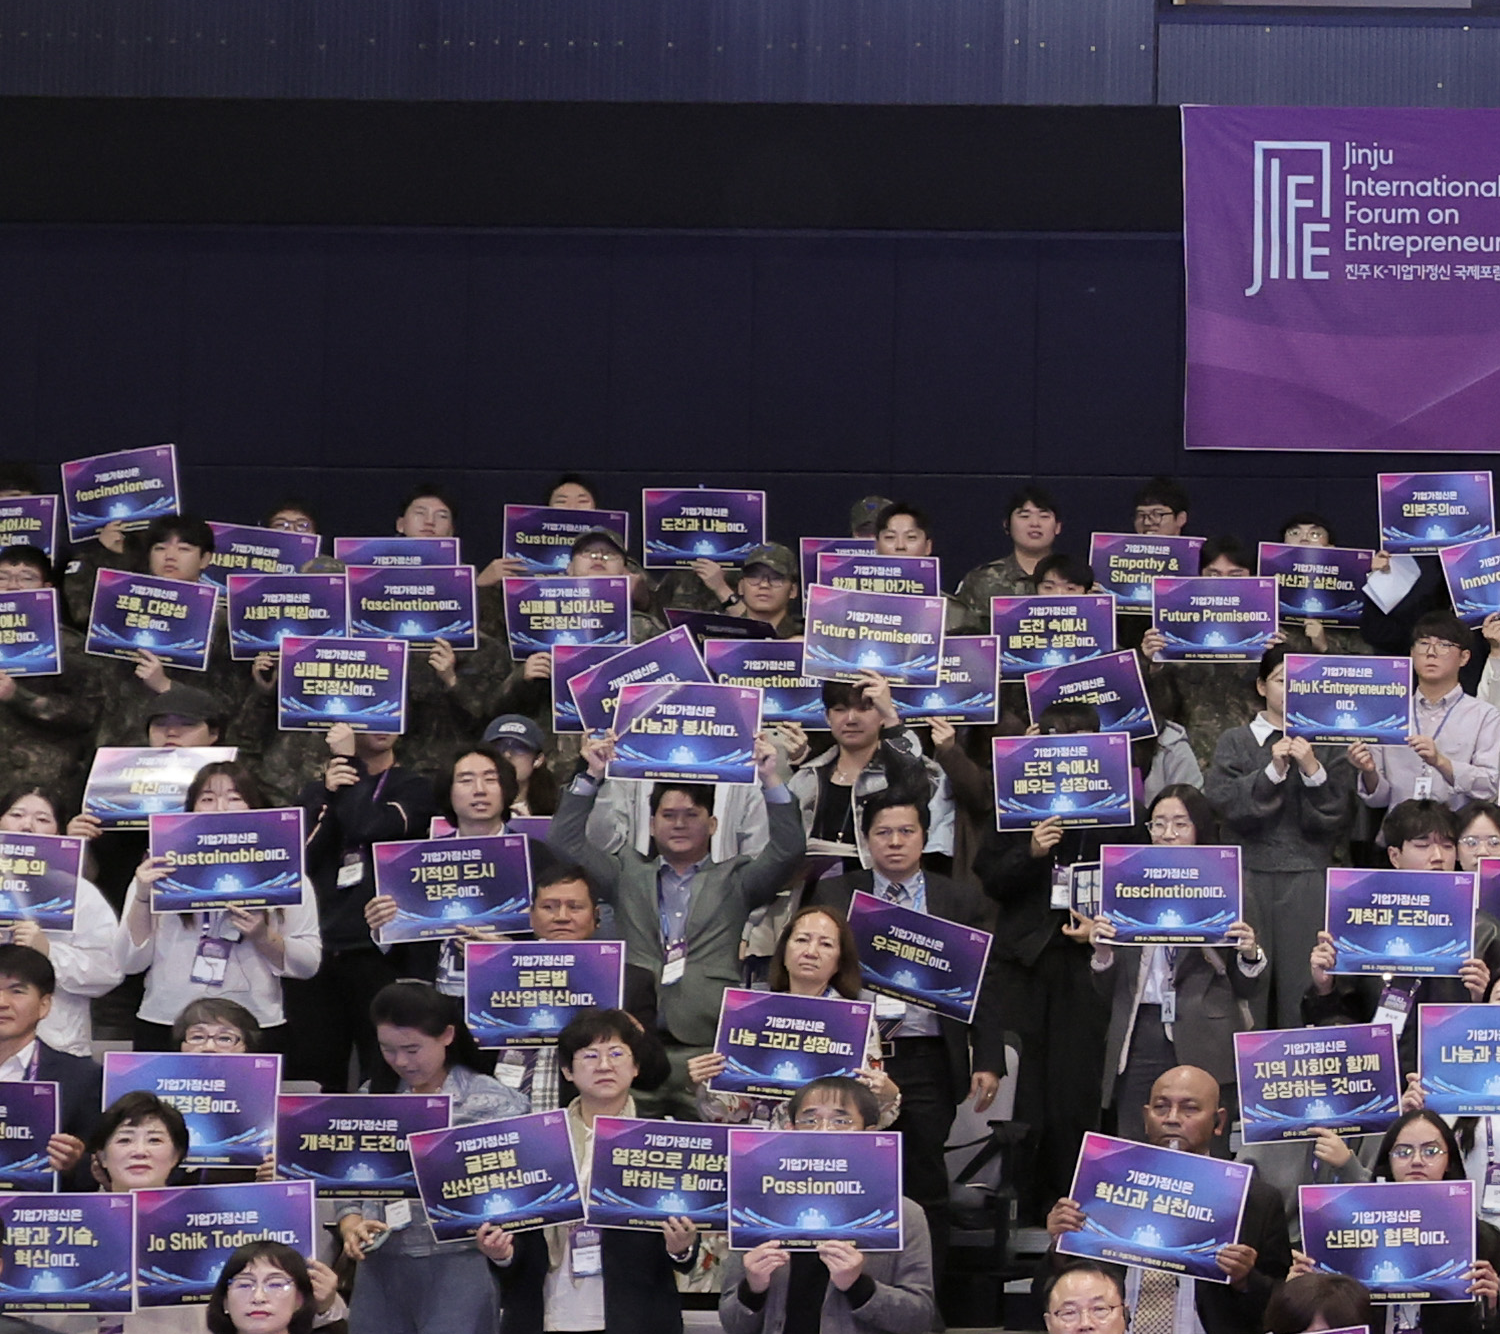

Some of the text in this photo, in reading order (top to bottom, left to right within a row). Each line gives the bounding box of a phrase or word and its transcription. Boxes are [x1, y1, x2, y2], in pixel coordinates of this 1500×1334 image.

[1342, 141, 1393, 171] Jinju
[1345, 200, 1459, 225] Forum on
[1344, 263, 1372, 280] 진주
[1373, 263, 1451, 281] K-기업가정신
[630, 718, 739, 737] 나눔과 봉사이다.
[1023, 758, 1099, 777] 도전 속에서
[1013, 776, 1113, 795] 배우는 성장이다.
[511, 955, 575, 967] 기업가정신은
[518, 969, 567, 988] 글로벌
[490, 989, 597, 1008] 신산업혁신이다.
[1283, 1040, 1348, 1056] 기업가정신은
[1253, 1053, 1380, 1079] 지역 사회와 함께
[1261, 1076, 1377, 1100] 성장하는 것이다.
